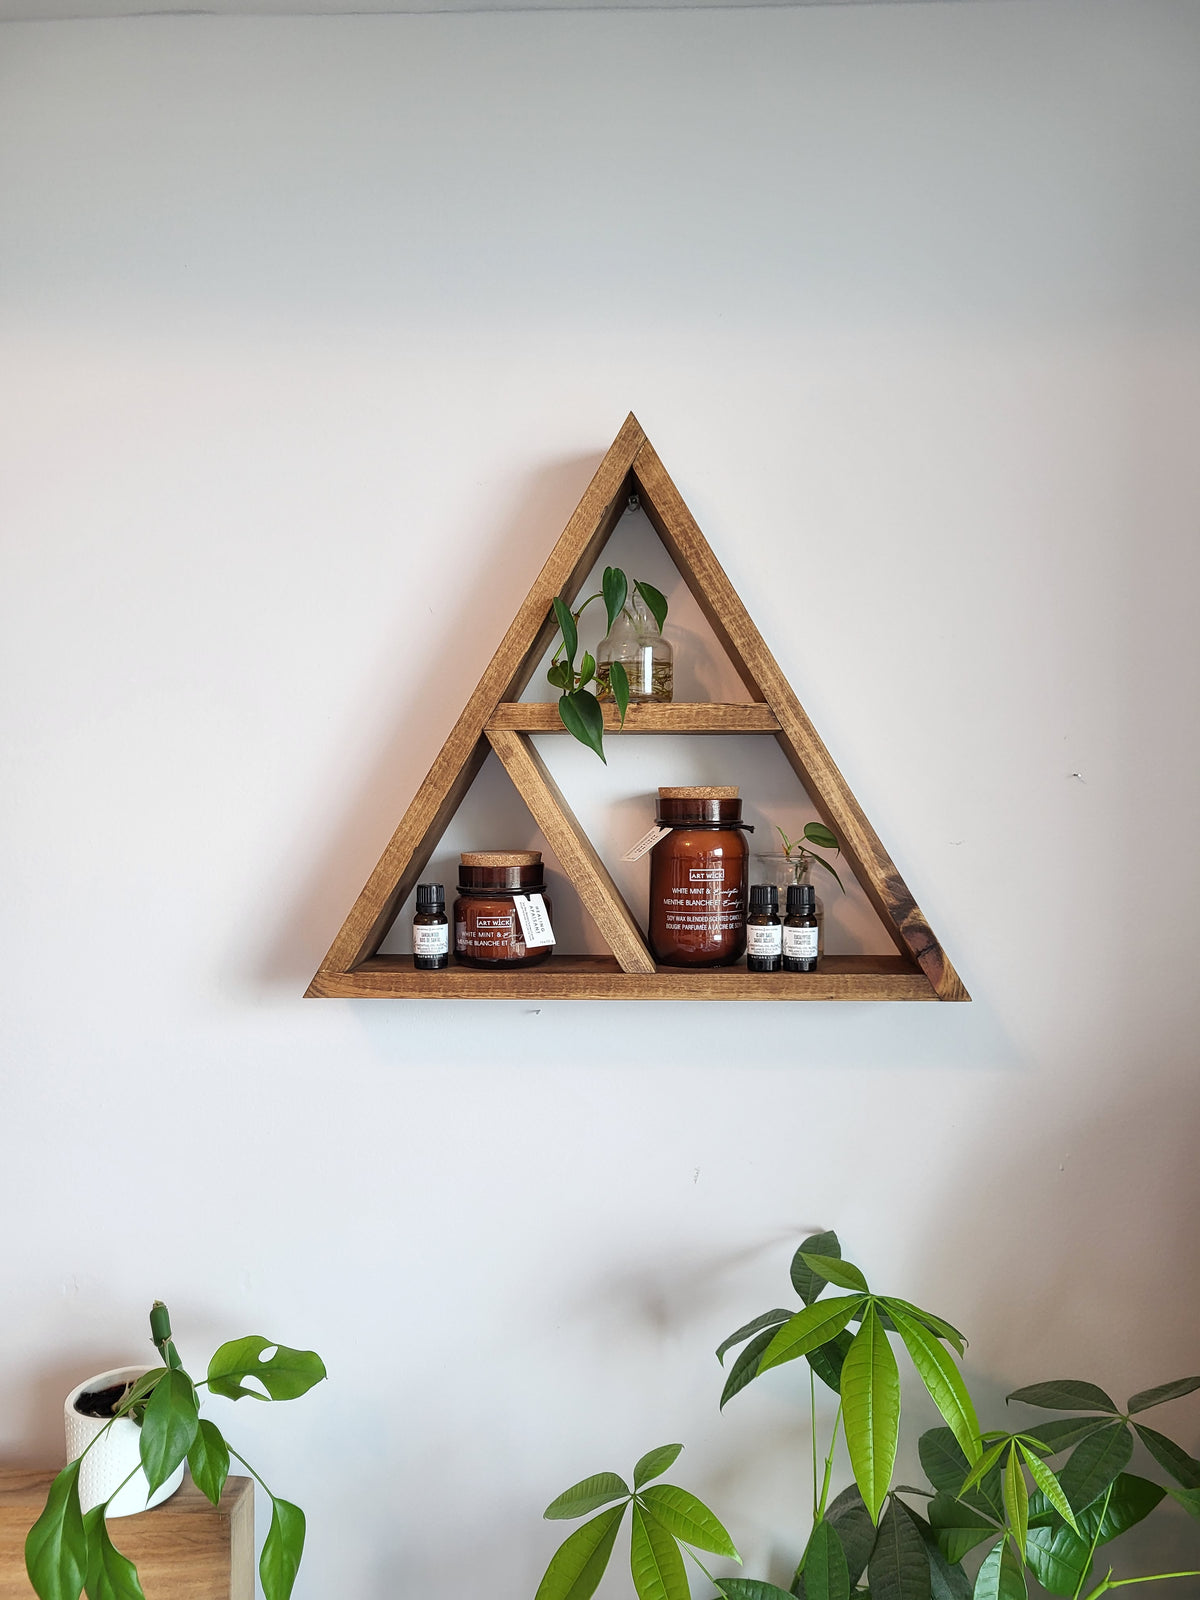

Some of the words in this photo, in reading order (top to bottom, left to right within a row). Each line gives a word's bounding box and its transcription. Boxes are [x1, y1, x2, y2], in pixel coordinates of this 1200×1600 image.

[705, 871, 723, 879] WICK
[671, 887, 688, 895] WHITE
[663, 898, 684, 906] MENTHE
[492, 918, 510, 926] WICK
[686, 915, 708, 923] BLENDED
